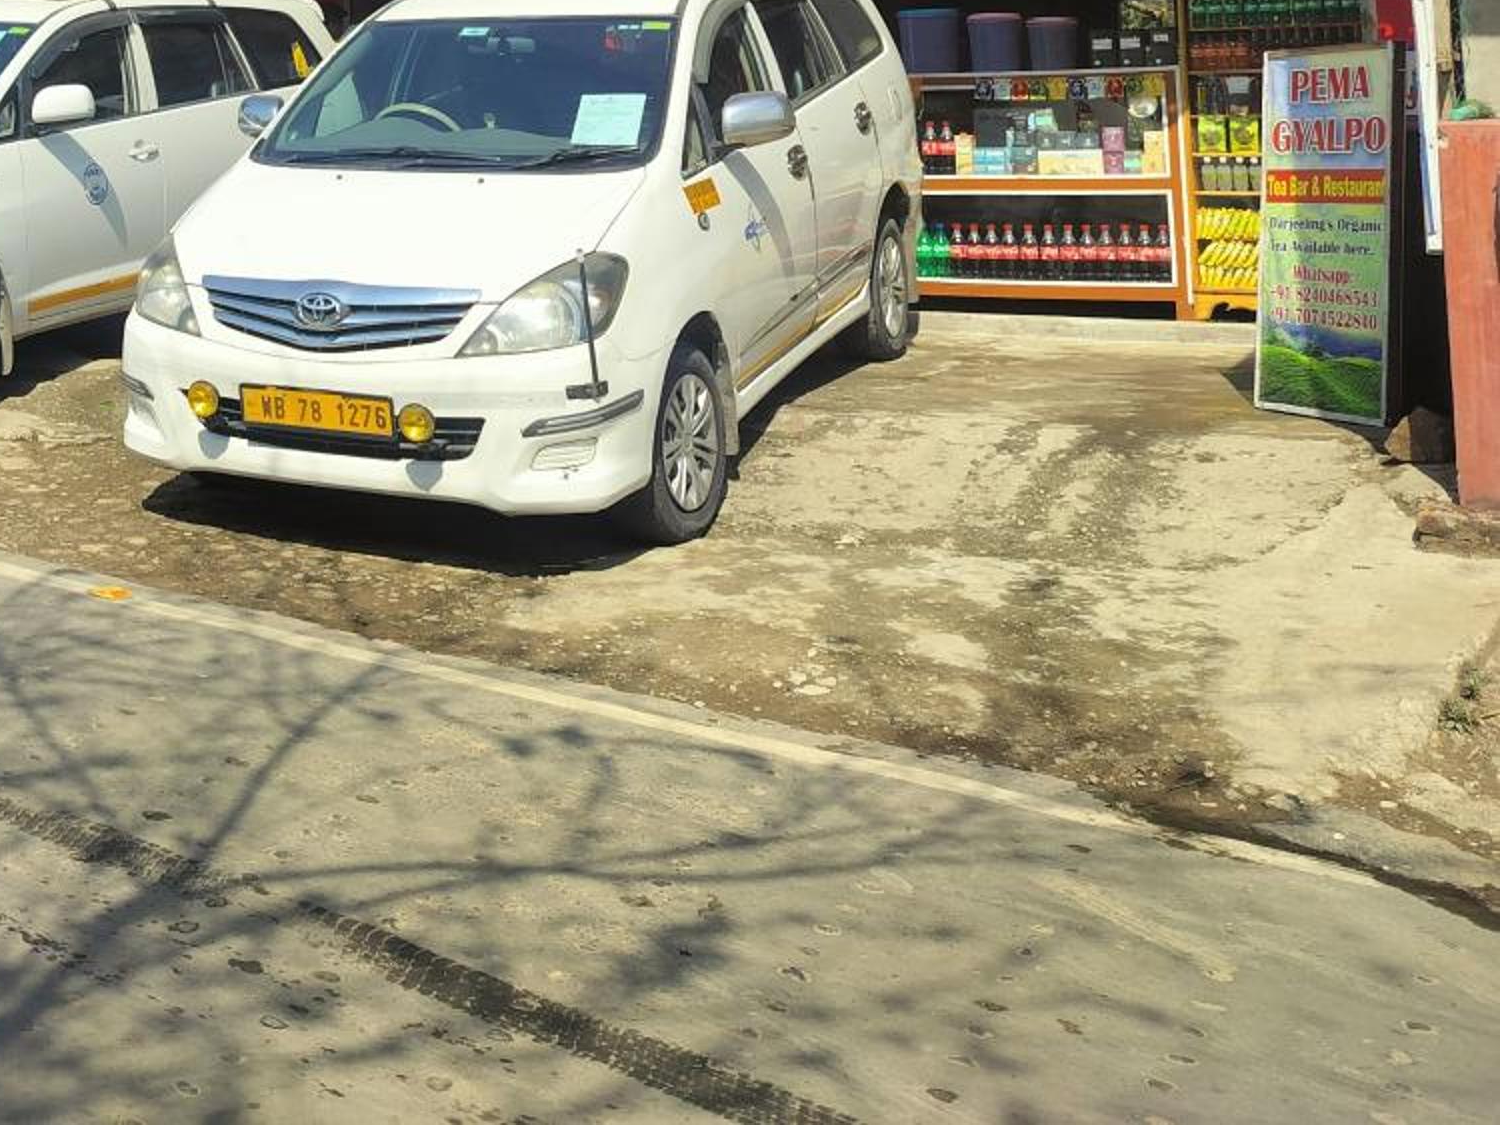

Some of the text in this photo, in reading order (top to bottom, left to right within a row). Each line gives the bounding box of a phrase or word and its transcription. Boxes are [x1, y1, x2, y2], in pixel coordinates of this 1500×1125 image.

[1290, 66, 1370, 105] PEMA
[1271, 115, 1388, 155] GYALPO
[1267, 175, 1386, 196] Tea Bar & Restaurant
[261, 394, 388, 429] WB 78 1276
